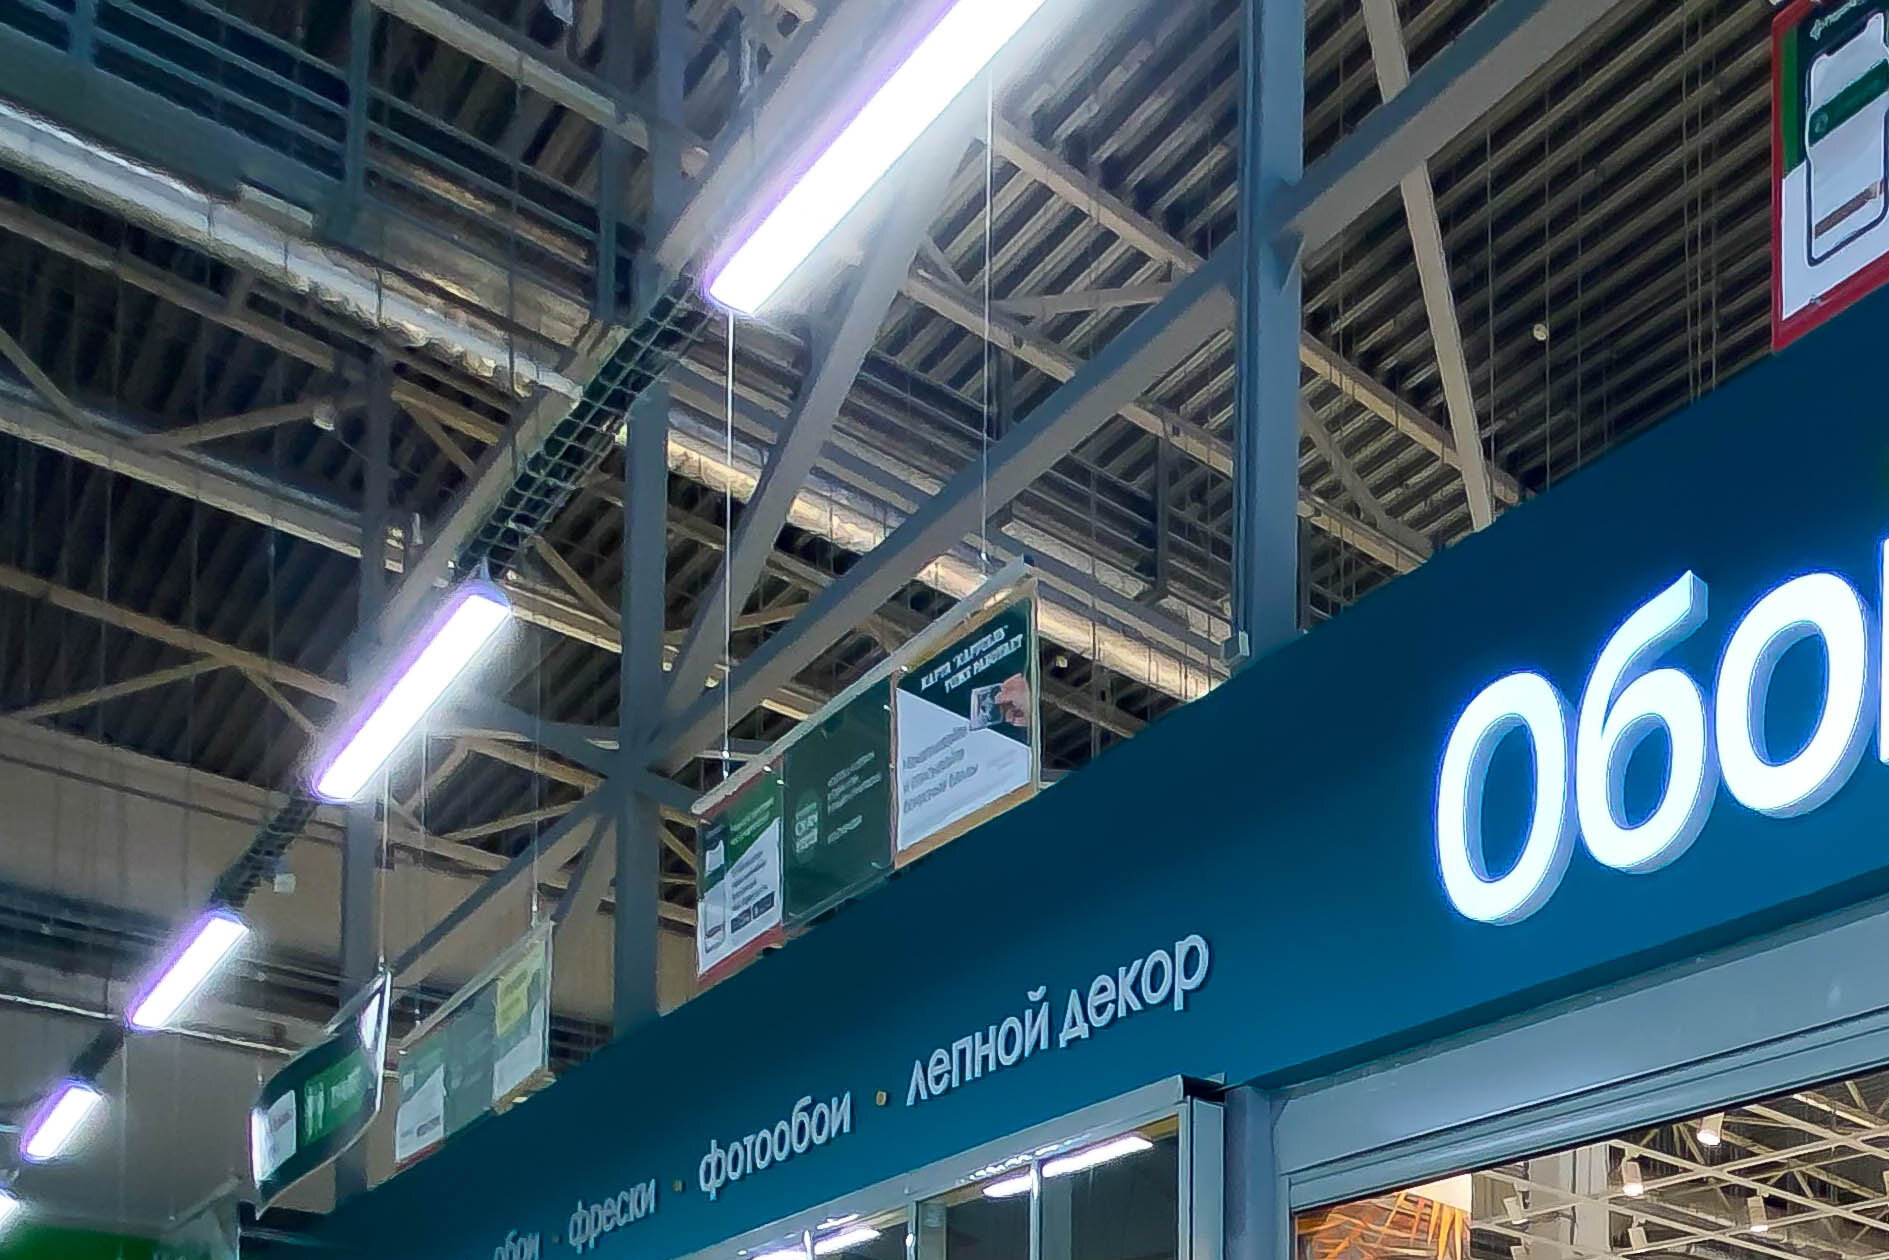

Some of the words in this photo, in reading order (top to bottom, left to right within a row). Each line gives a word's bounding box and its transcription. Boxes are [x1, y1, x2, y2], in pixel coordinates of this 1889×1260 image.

[568, 1178, 656, 1254] фрески
[699, 1090, 853, 1200] фотообои
[906, 985, 1050, 1106] лепной
[1058, 934, 1209, 1048] декор
